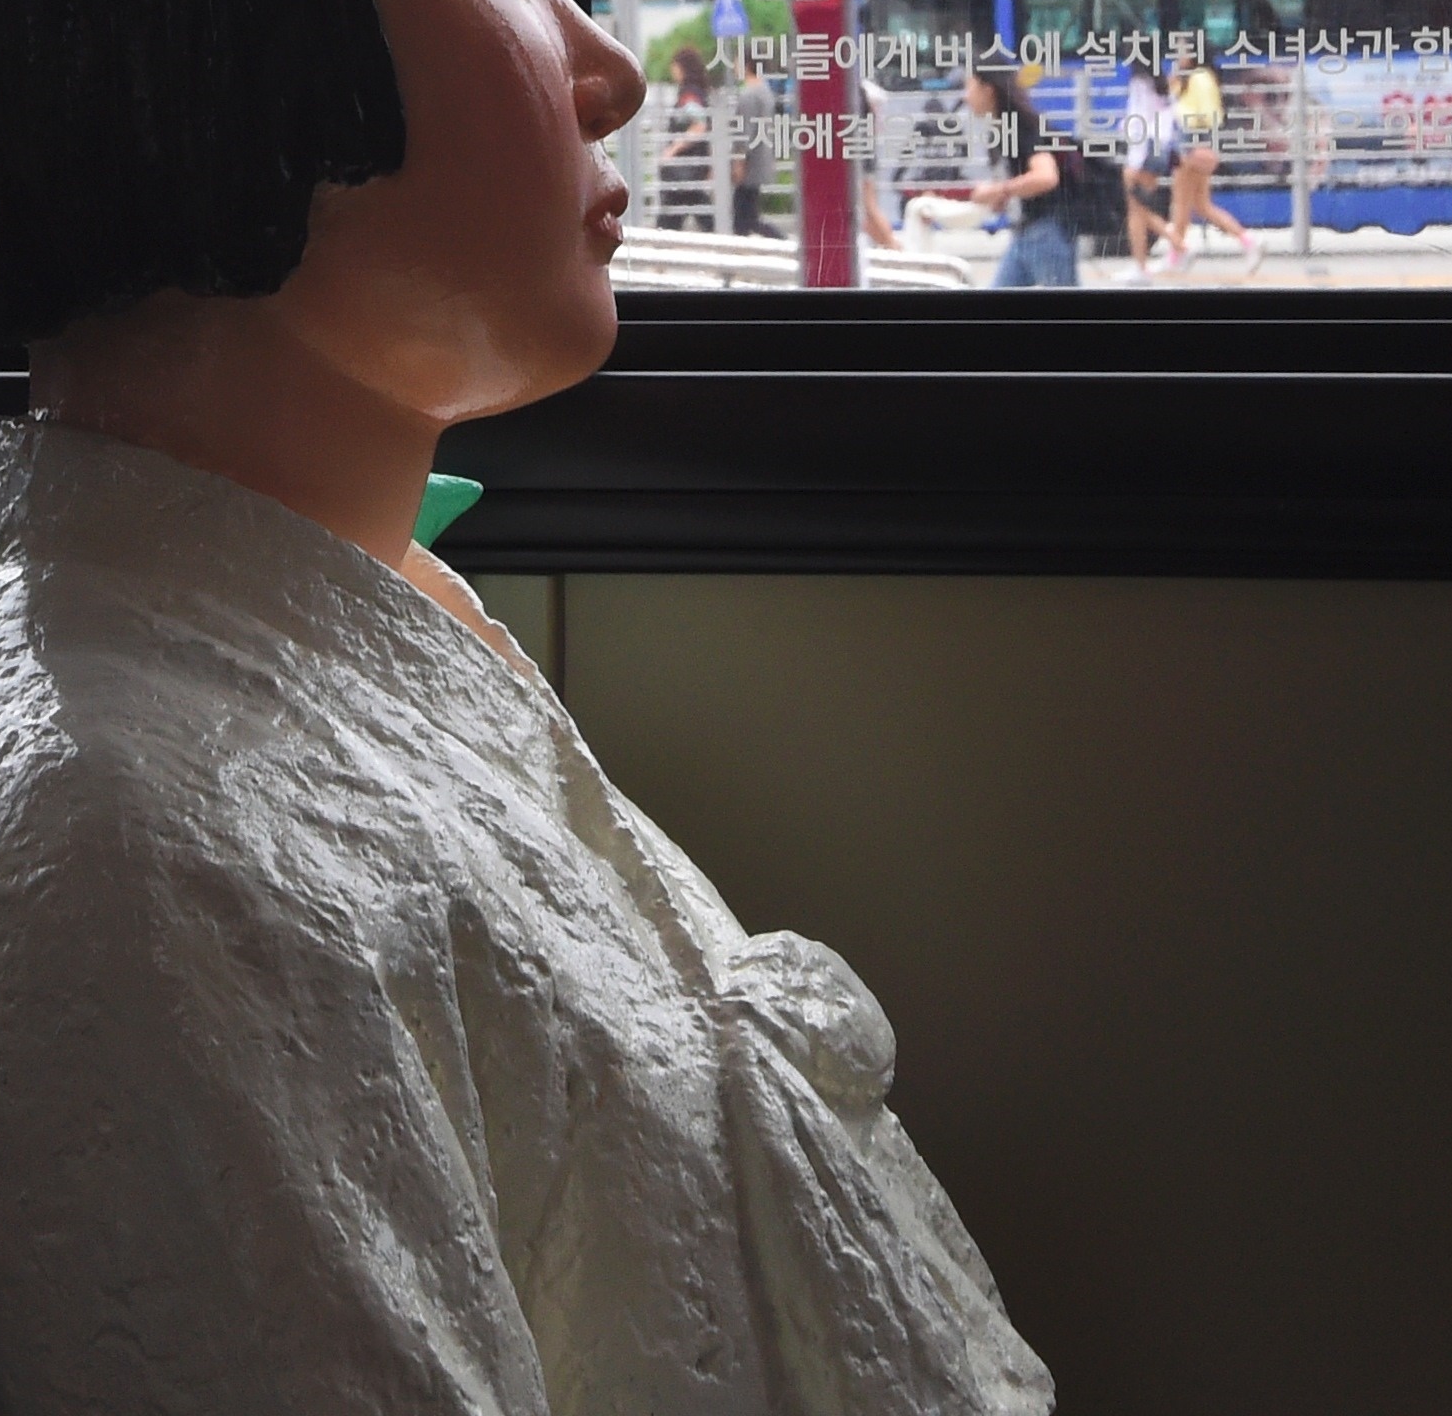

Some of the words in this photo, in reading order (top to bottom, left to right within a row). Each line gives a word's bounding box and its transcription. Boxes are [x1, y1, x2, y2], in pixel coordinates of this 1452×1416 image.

[705, 31, 918, 81] 시민들에게
[935, 30, 1061, 80] 버스에
[1075, 28, 1206, 79] 설치된
[1222, 26, 1400, 76] 소녀상과
[936, 109, 1020, 159] 위해
[1033, 110, 1161, 158] 도움이
